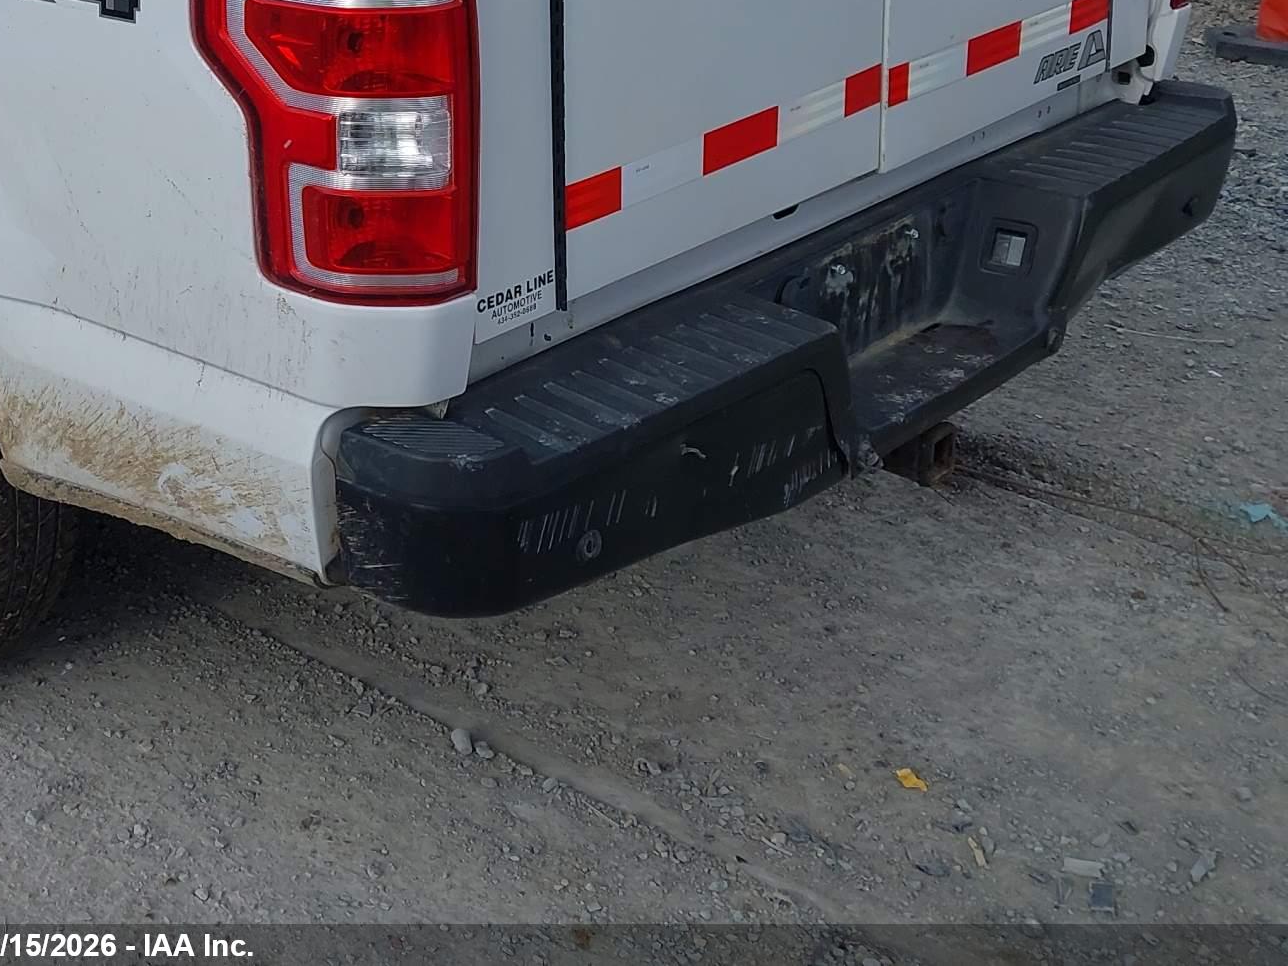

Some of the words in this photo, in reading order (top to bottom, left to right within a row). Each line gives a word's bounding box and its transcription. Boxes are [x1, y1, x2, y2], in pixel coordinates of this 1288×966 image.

[1032, 41, 1082, 85] ARE
[476, 284, 523, 313] CEDAR
[525, 269, 554, 293] LINE
[491, 289, 543, 320] AUTOMOTIVE
